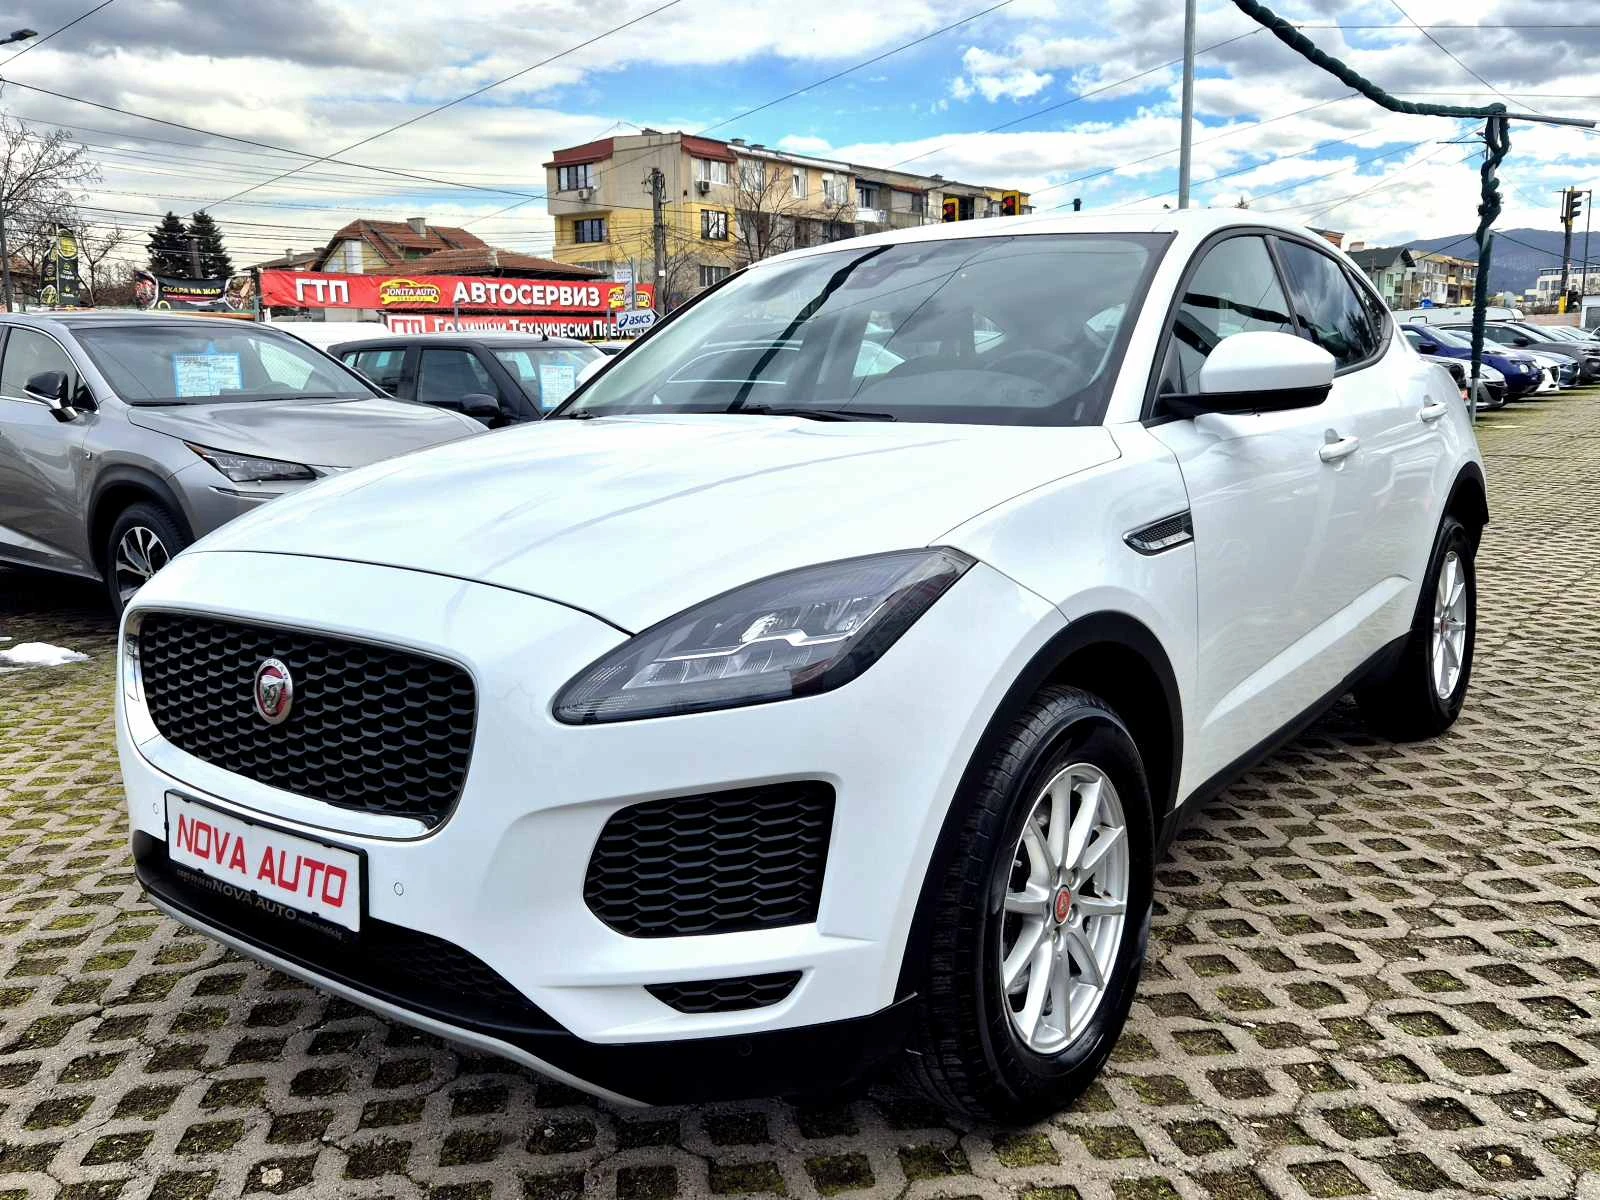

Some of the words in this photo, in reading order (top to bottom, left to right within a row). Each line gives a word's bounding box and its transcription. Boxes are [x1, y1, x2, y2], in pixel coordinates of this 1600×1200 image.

[296, 278, 349, 303] ГТП
[416, 288, 437, 296] AUTO
[453, 281, 600, 308] АВТОСЕРВИЗ
[176, 814, 247, 874] NOVA
[257, 846, 347, 908] AUTO
[211, 879, 253, 905] NOVA
[255, 898, 297, 921] AUTO
